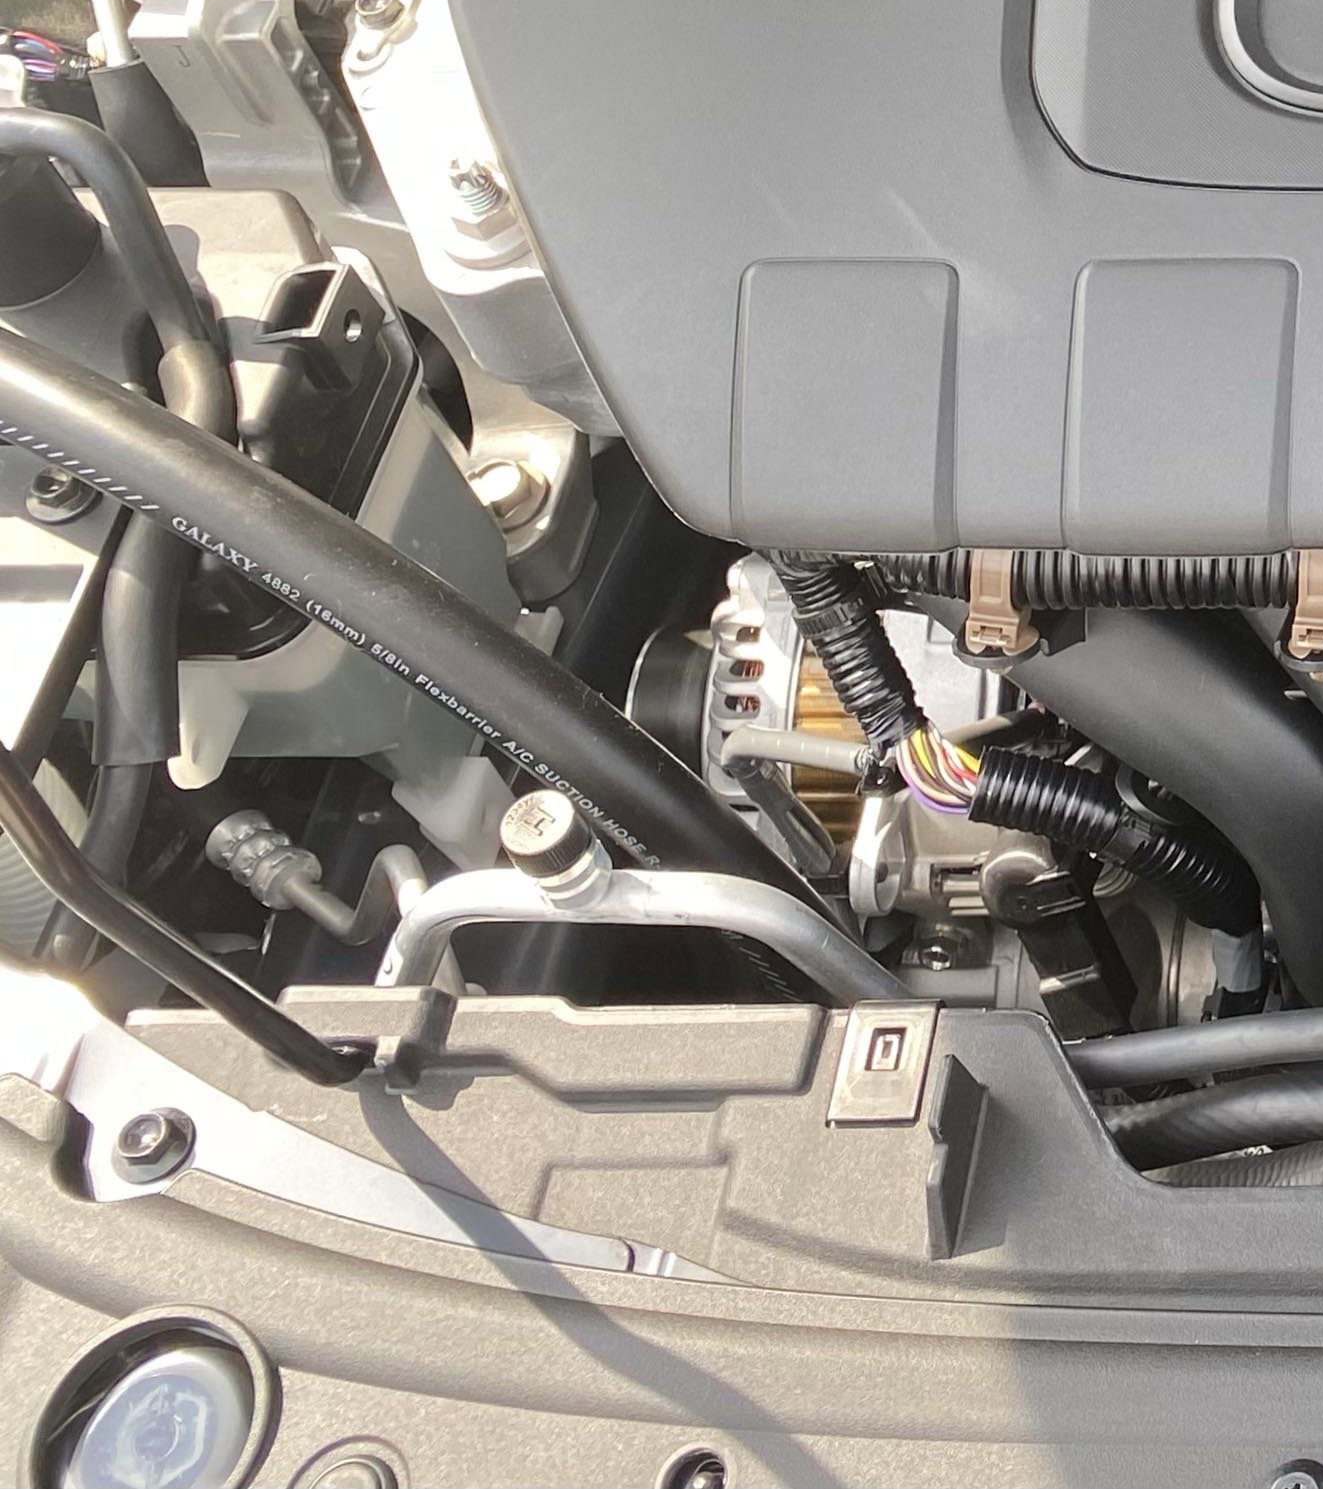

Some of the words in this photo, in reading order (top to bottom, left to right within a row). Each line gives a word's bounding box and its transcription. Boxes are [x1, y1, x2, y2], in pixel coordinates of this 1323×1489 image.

[171, 516, 259, 573] GALAXY
[261, 572, 301, 602] 4882
[305, 599, 366, 646] (16mm)
[415, 674, 502, 739] Flexbarrier
[502, 740, 534, 763] A/C
[534, 763, 604, 818] SUCTION
[603, 819, 647, 853] HOSE
